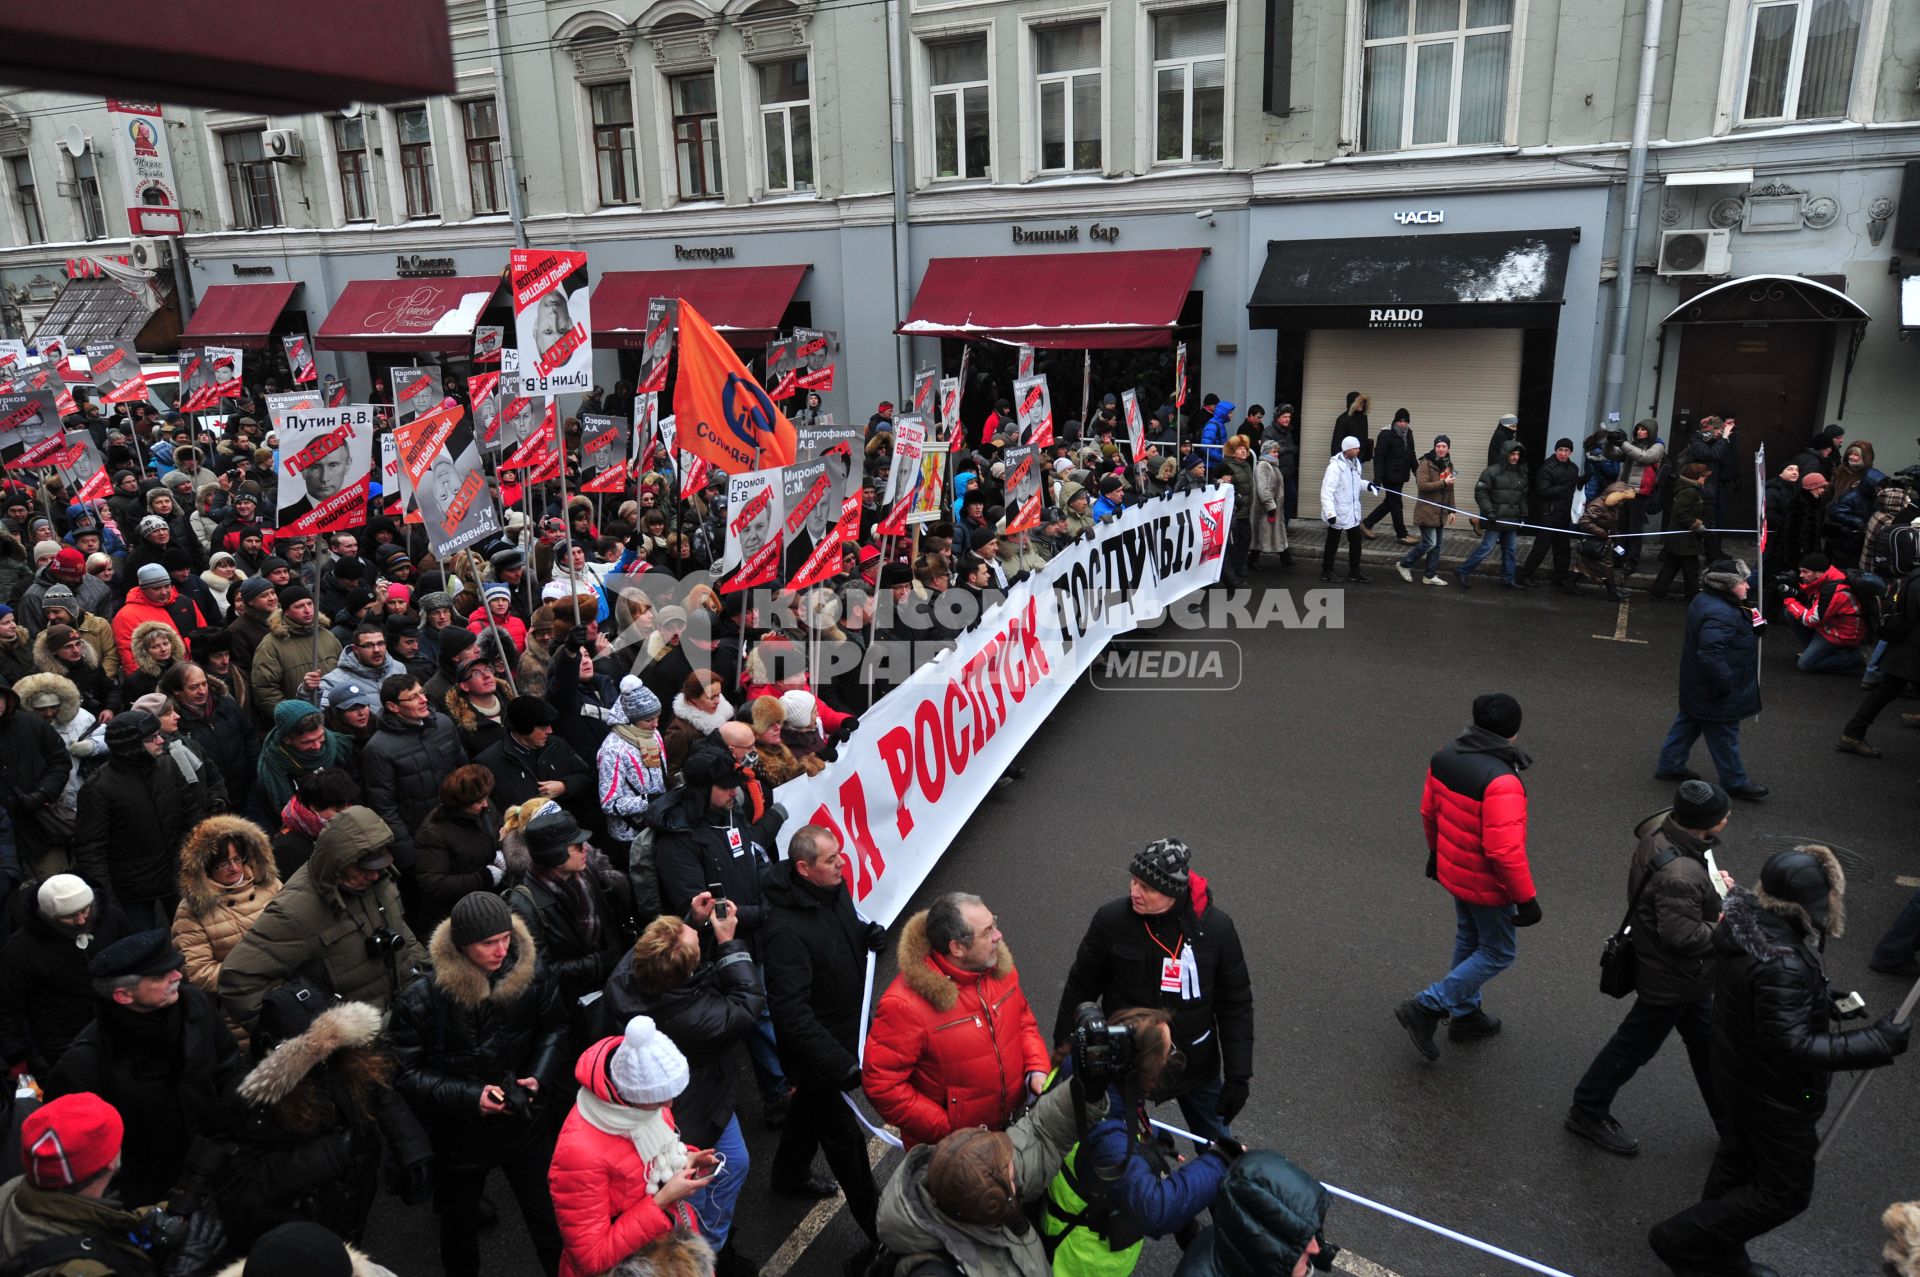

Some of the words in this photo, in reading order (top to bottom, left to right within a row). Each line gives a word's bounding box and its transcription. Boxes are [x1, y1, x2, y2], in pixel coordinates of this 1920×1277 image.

[1393, 210, 1444, 224] ЧАСЫ
[1012, 225, 1079, 243] Винный
[1089, 223, 1120, 244] бар
[674, 244, 735, 261] Ресторан
[515, 254, 558, 290] ПОДЛЕЦОВ
[549, 258, 573, 282] МАРШ
[518, 277, 551, 305] ПРОТИВ
[1370, 309, 1423, 321] RADO
[795, 328, 824, 337] Слуцкий
[533, 321, 588, 379] ПОЗОР!
[394, 369, 422, 377] Карпов
[552, 371, 588, 387] Путин
[521, 377, 548, 391] В.В.
[267, 394, 320, 403] Калашников
[286, 416, 336, 431] Путин
[341, 411, 371, 425] В.В.
[434, 417, 453, 442] МАРШ
[584, 416, 611, 425] Озеров
[584, 424, 600, 432] А.А.
[406, 420, 437, 465] ПОДЛЕЦОВ
[799, 429, 856, 442] Митрофанов
[898, 426, 906, 438] ЗА
[283, 422, 356, 477] ПОЗОР!
[696, 421, 756, 470] Солидар
[799, 440, 817, 449] А.В.
[1006, 447, 1031, 457] Федоров
[411, 442, 437, 478] ПРОТИВ
[731, 476, 765, 491] Громов
[784, 463, 825, 483] Миронов
[731, 491, 750, 503] Б.В.
[784, 483, 806, 496] С.М.
[298, 505, 327, 530] МАРШ
[326, 484, 364, 511] ПРОТИВ
[315, 495, 365, 530] ПОДЛЕЦОВ
[729, 484, 775, 538] ПОЗОР!
[785, 471, 832, 534] ПОЗОР!
[438, 518, 498, 556] Тарнавский
[734, 562, 754, 584] МАРШ
[752, 542, 777, 568] ПРОТИВ
[797, 560, 817, 583] МАРШ
[815, 530, 840, 564] ПРОТИВ
[809, 542, 841, 581] ПОДЛЕЦОВ
[745, 551, 778, 585] ПОДЛЕЦОВ
[878, 594, 1049, 840] РОСПУСК
